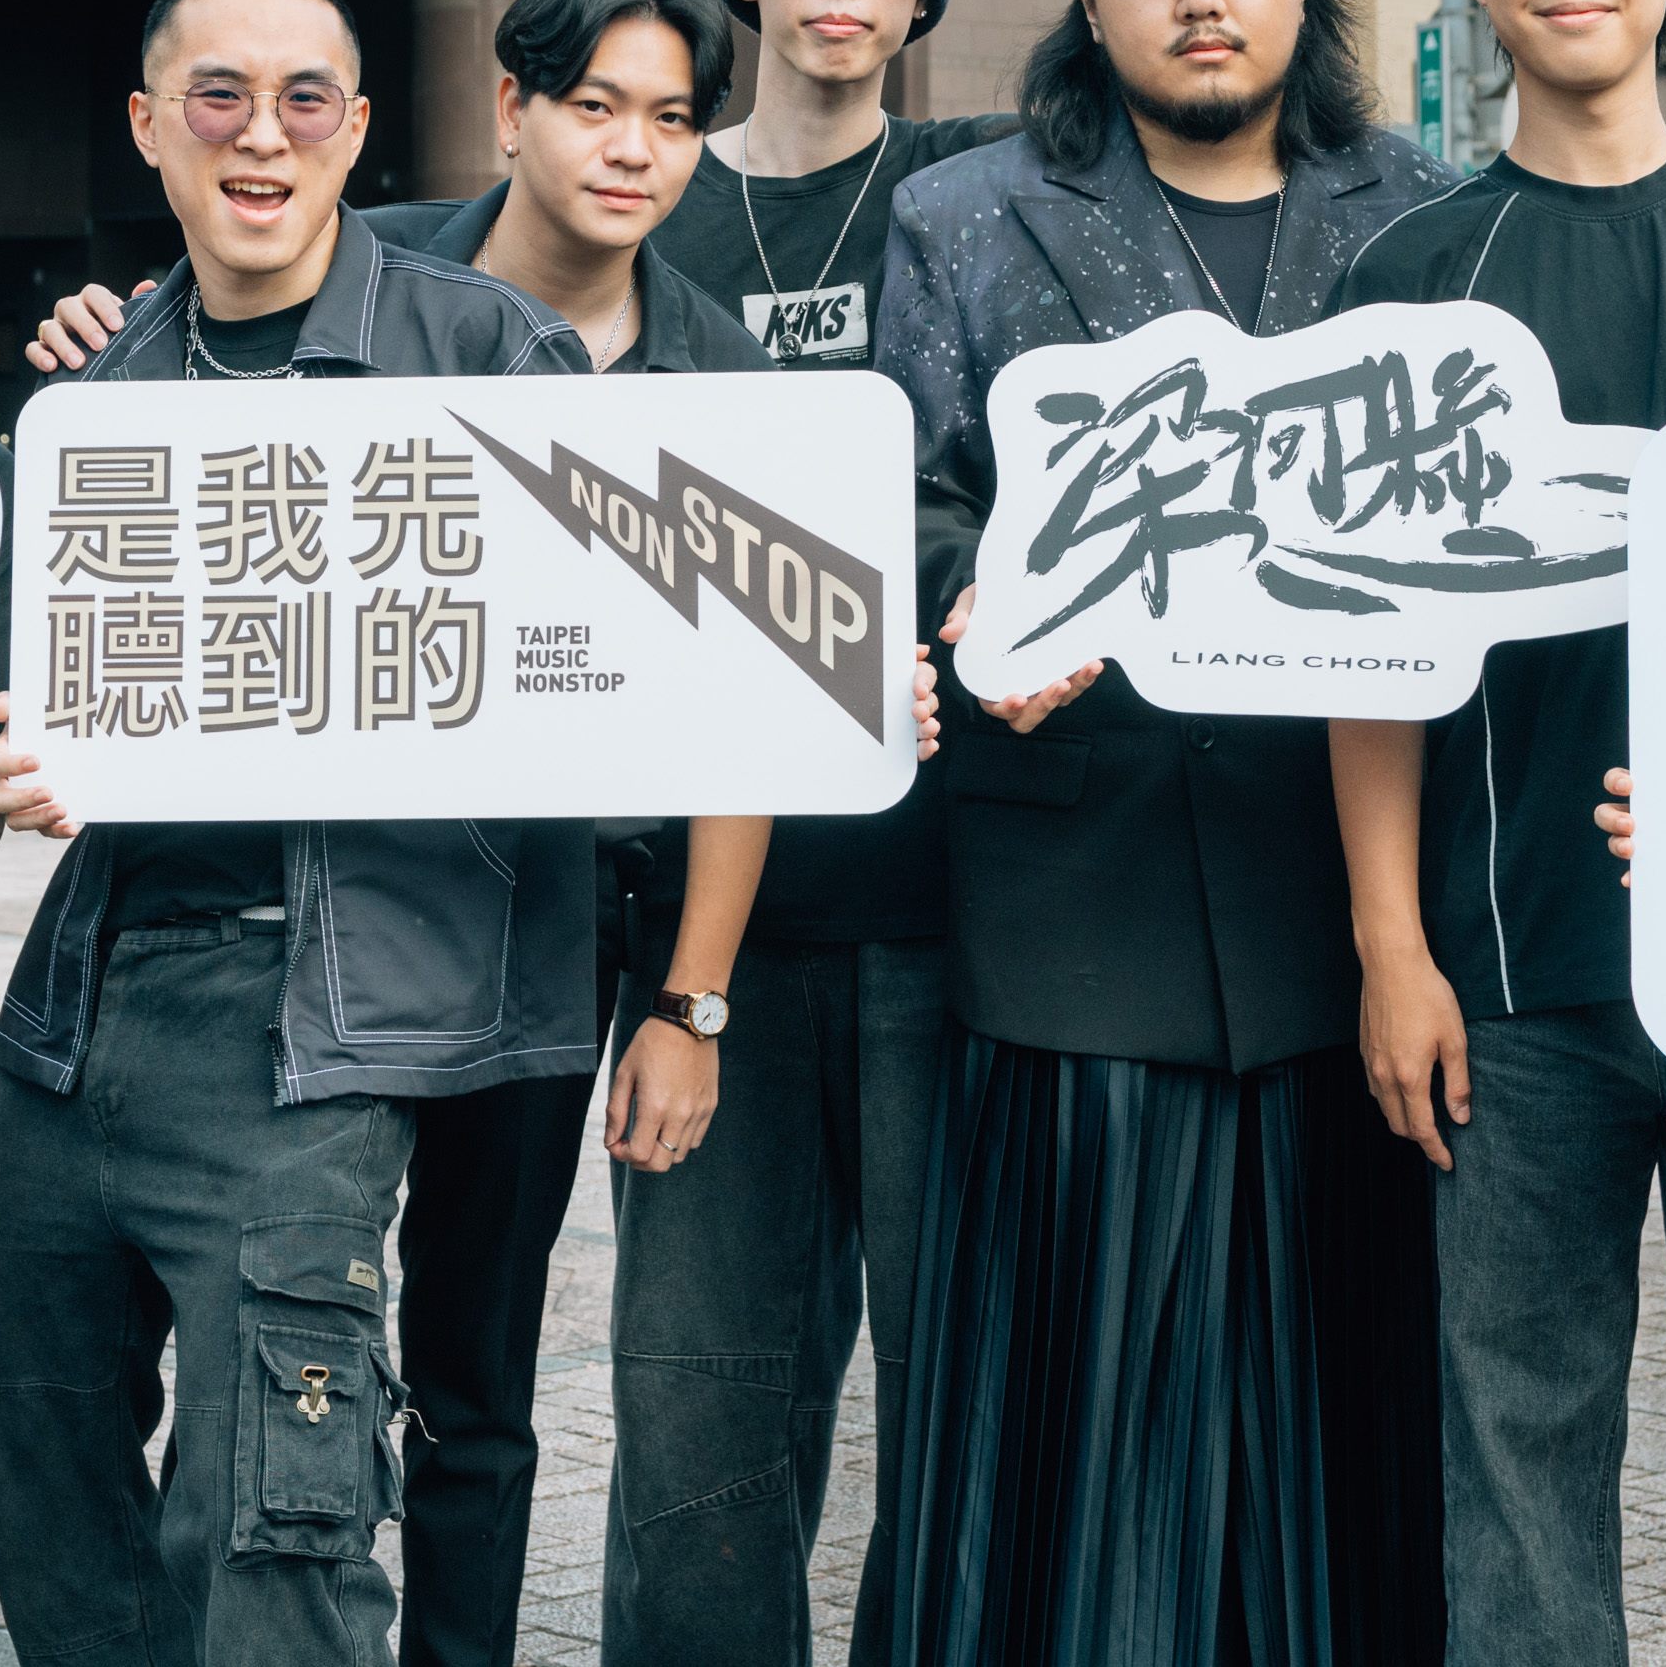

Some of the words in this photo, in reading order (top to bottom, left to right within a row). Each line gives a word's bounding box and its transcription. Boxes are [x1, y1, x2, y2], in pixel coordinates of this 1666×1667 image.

[45, 437, 484, 586] 是我先
[570, 468, 675, 589] NON
[680, 484, 871, 672] STOP
[516, 625, 591, 646] TAIPEI
[45, 587, 488, 739] 聽到的
[516, 650, 590, 670] MUSIC
[1172, 651, 1286, 668] LIANG
[1302, 656, 1437, 673] CHORD
[516, 674, 626, 694] NONSTOP
